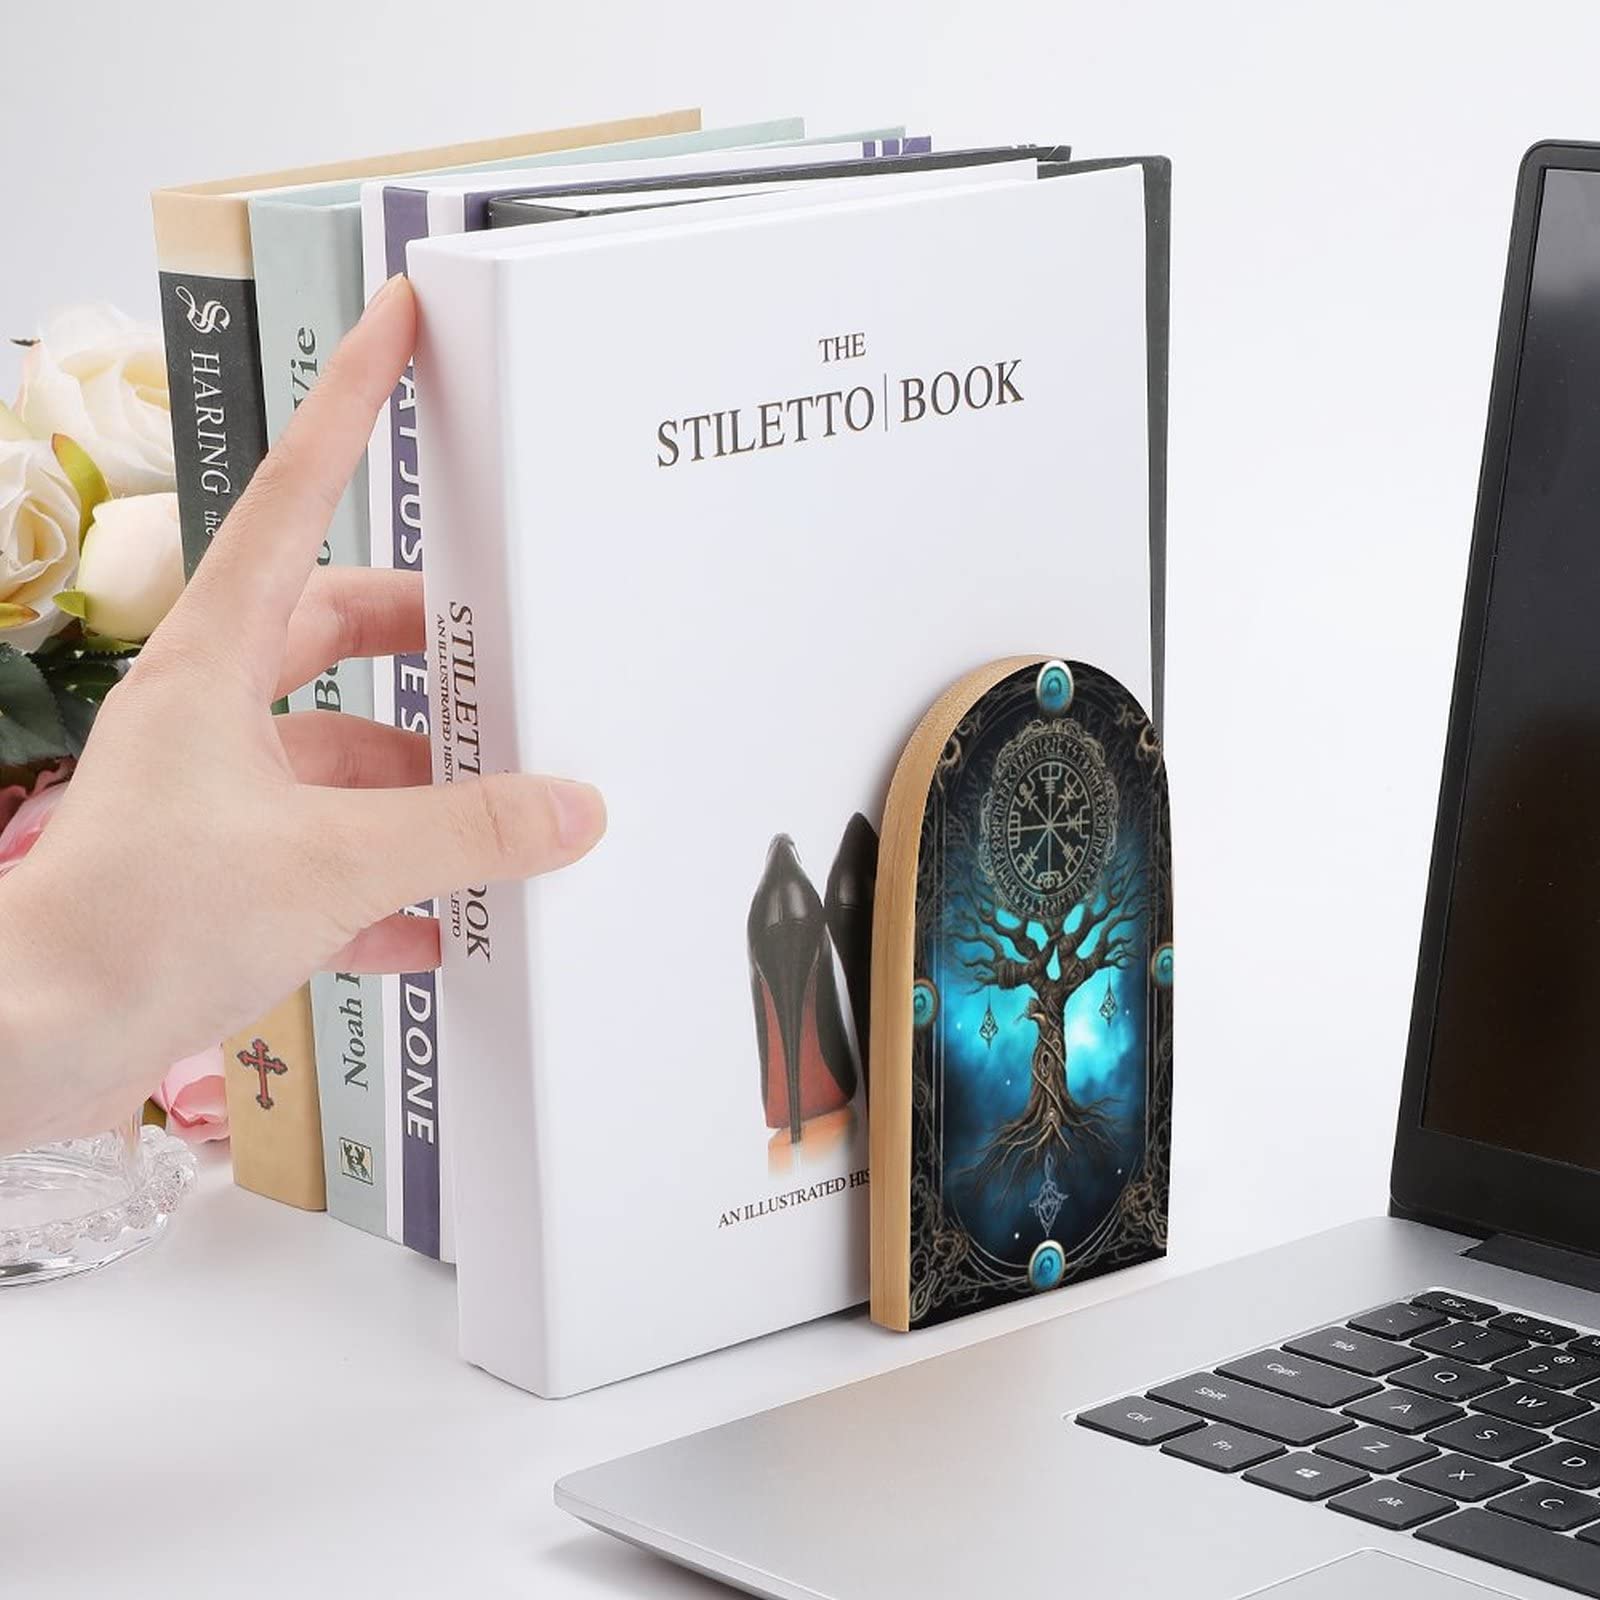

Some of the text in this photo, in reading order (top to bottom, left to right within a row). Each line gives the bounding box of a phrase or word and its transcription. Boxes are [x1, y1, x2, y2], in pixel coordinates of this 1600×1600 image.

[818, 332, 867, 363] THE
[657, 359, 1025, 468] STILETTO BOOK
[437, 614, 446, 637] AN
[438, 640, 452, 742] ILLUSTRATED
[339, 997, 369, 1091] Noah
[405, 983, 435, 1144] DONE
[718, 1208, 741, 1228] AN
[744, 1177, 846, 1220] ILLUSTRATED
[1433, 1372, 1459, 1383] Q
[1389, 1403, 1412, 1414] A
[1516, 1395, 1548, 1409] W
[1475, 1429, 1499, 1441] S
[1361, 1441, 1391, 1454] Z
[1561, 1456, 1587, 1468] D
[1447, 1469, 1477, 1481] X
[1539, 1498, 1565, 1510] C
